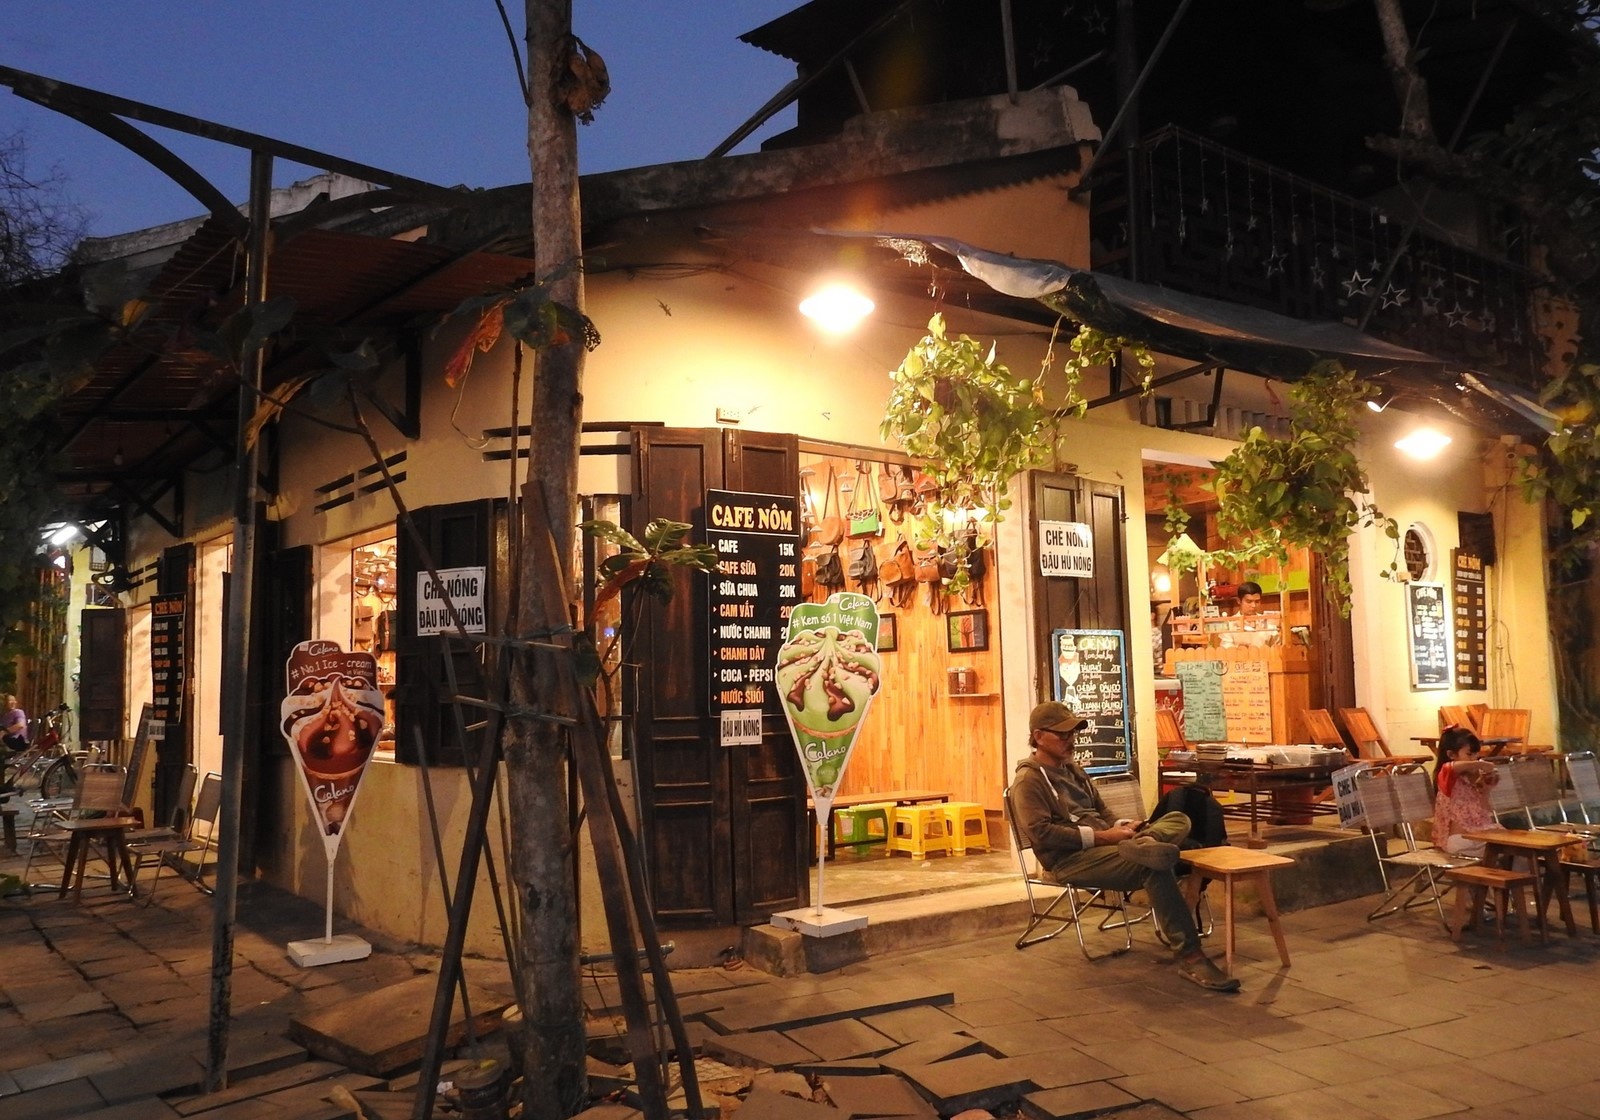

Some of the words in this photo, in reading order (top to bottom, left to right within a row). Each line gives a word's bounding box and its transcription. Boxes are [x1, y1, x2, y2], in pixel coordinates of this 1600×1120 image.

[712, 504, 754, 528] CAFE
[758, 503, 793, 531] NÔM
[1046, 526, 1064, 546] CHÈ
[1066, 528, 1089, 548] NÓN
[718, 539, 738, 553] CAFE
[778, 543, 795, 556] 15K
[719, 561, 739, 575] CAFE
[740, 560, 757, 575] SỮA
[779, 564, 796, 577] 20K
[1042, 551, 1059, 573] ĐẬU
[1073, 552, 1092, 571] NÓNG
[447, 574, 478, 598] NÓNG
[720, 580, 736, 596] SỮA
[737, 583, 758, 597] CHUA
[779, 585, 796, 598] 20K
[720, 604, 738, 618] CAM
[780, 606, 793, 618] 20
[840, 597, 870, 611] Celano
[419, 606, 437, 632] ĐẬU
[792, 618, 799, 629] #
[801, 615, 819, 626] Kem
[820, 613, 831, 624] số
[833, 613, 837, 624] 1
[838, 614, 854, 627] Việt
[854, 616, 872, 630] Nam
[720, 623, 743, 640] NƯỚC
[743, 626, 771, 640] CHANH
[308, 643, 338, 656] Celano
[720, 647, 748, 661] CHANH
[749, 645, 766, 660] DÂY
[291, 668, 300, 679] #
[301, 661, 320, 676] No.1
[322, 660, 338, 670] Ice
[346, 660, 372, 670] cream
[721, 669, 743, 682] COCA
[749, 669, 774, 682] PEPSI
[721, 688, 743, 704] NƯỚC
[745, 686, 764, 704] SUỐI
[743, 714, 760, 736] NÓNG
[805, 741, 846, 761] Celano
[314, 782, 355, 803] Celano
